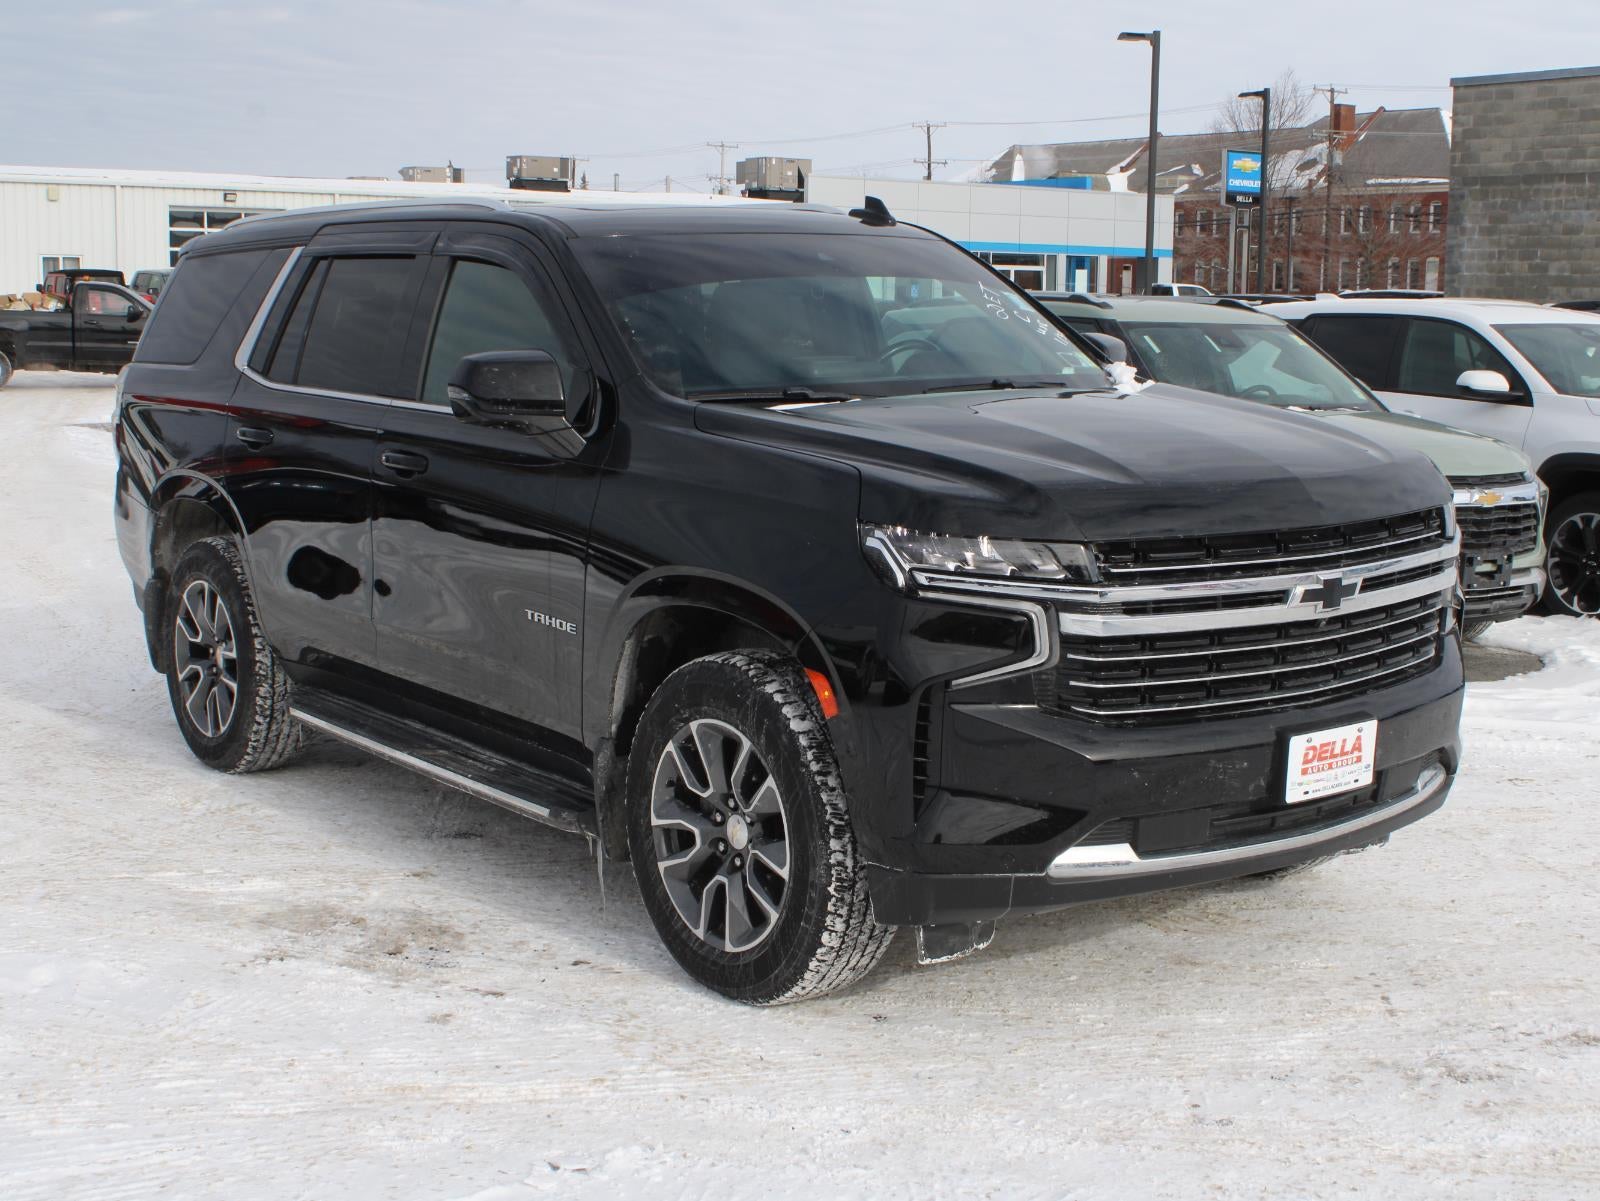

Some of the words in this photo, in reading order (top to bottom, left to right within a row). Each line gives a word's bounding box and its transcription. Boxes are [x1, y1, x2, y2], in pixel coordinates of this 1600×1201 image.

[1229, 178, 1261, 188] CHEVROLET
[1236, 195, 1253, 203] DELLA
[524, 609, 577, 635] TAHOE
[1302, 734, 1362, 765] DELLA
[1307, 763, 1329, 775] AUTO
[1332, 757, 1357, 769] GROUP
